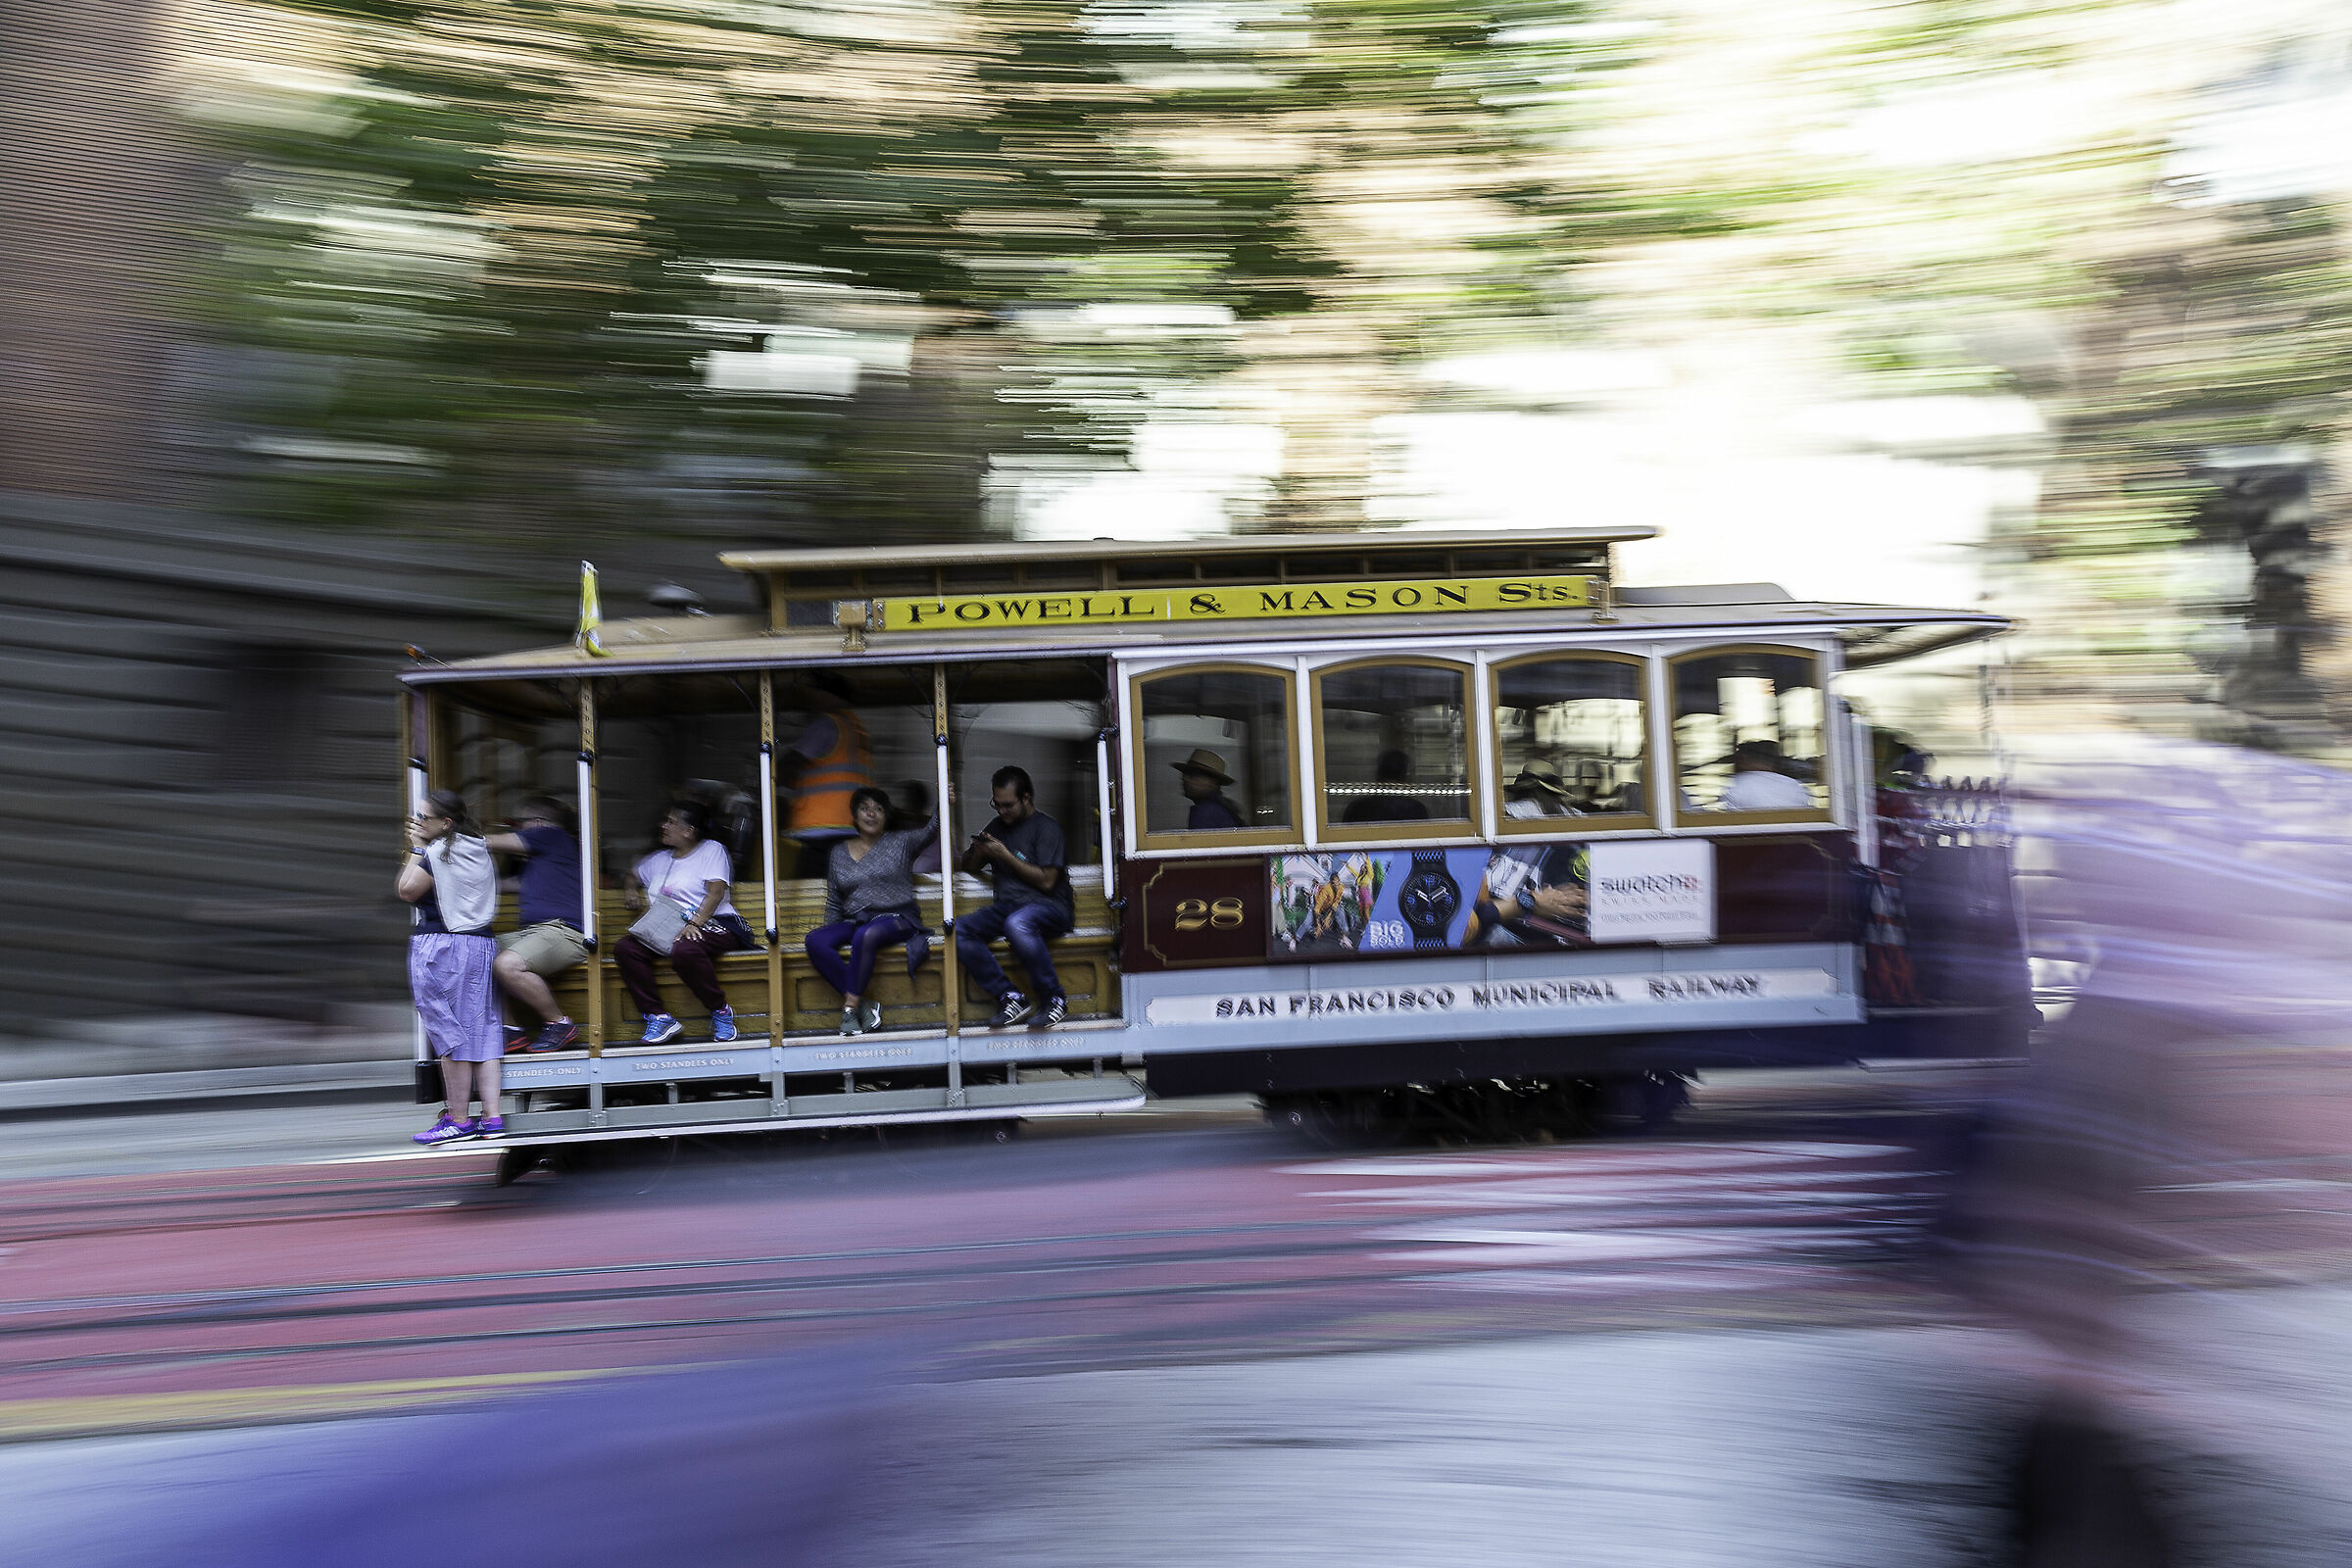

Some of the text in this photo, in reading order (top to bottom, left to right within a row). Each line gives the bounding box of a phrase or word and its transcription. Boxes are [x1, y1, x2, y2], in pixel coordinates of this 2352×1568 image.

[907, 582, 1578, 623] POWELL & MASON Sts.
[1599, 874, 1683, 894] swatch
[1175, 897, 1244, 931] 28
[1369, 920, 1404, 937] BIG
[1216, 974, 1761, 1020] SAN FRANCISCO MUNICIPAL RAILWAY
[506, 1065, 581, 1078] STANDEES ONLY
[635, 1056, 735, 1071] TWO STANDEES ONLY
